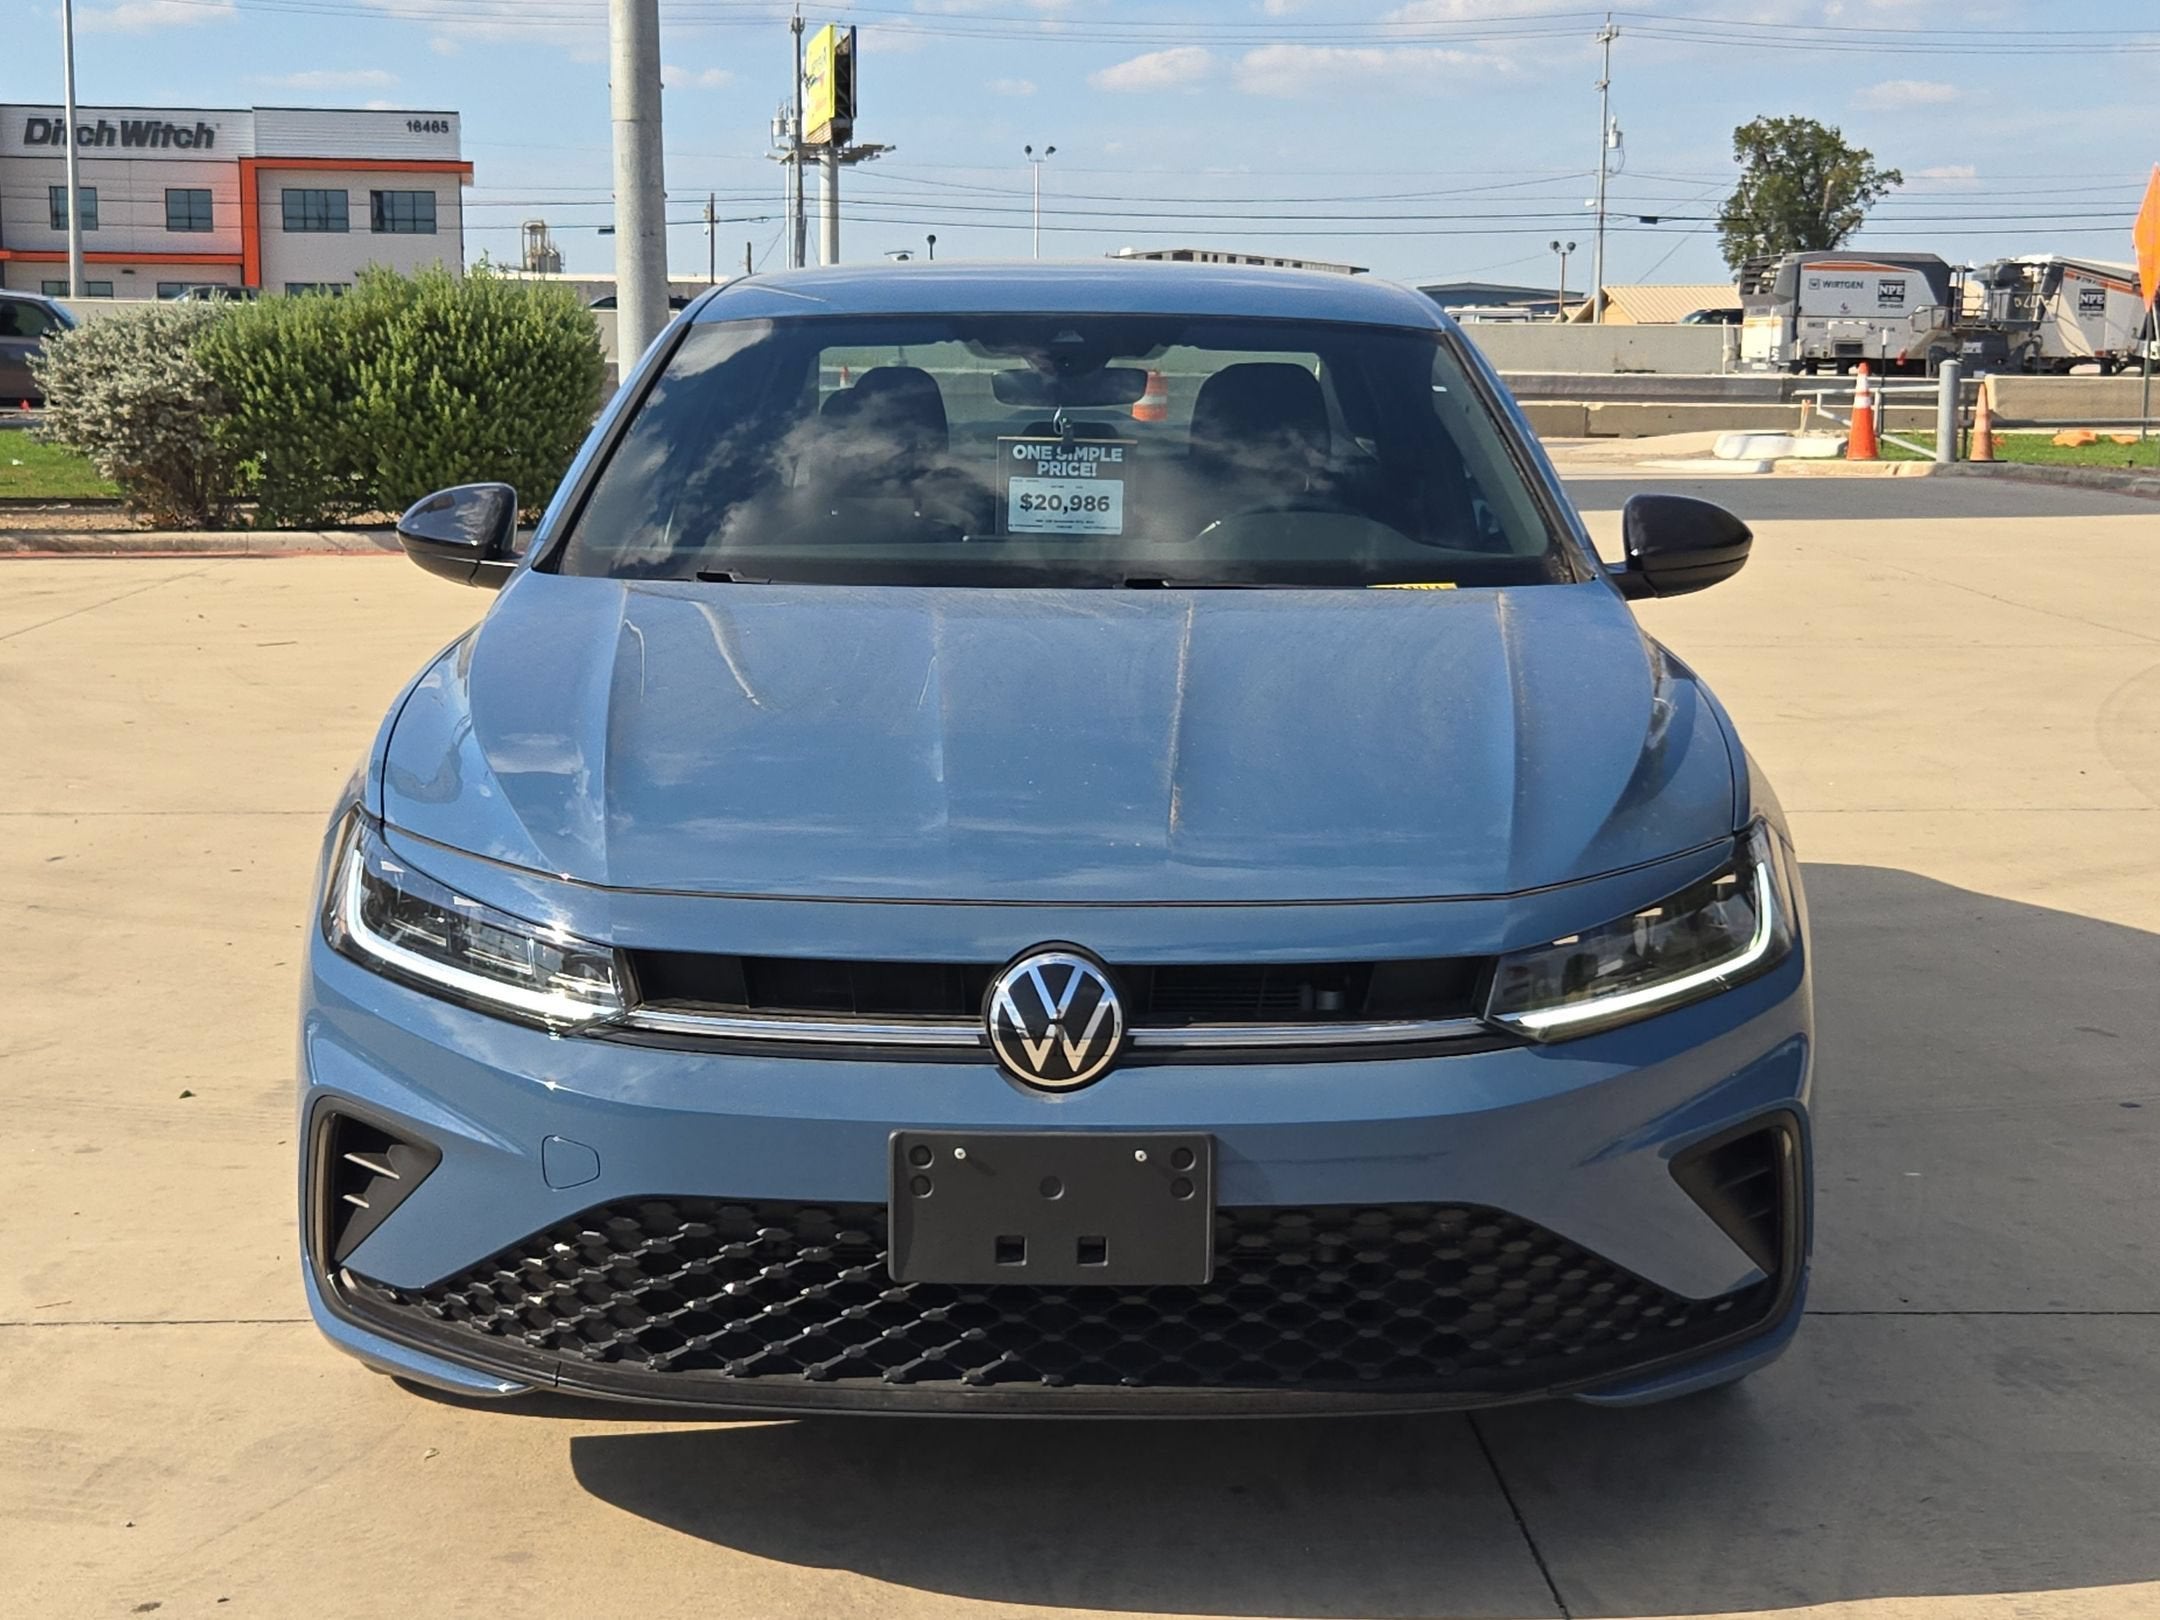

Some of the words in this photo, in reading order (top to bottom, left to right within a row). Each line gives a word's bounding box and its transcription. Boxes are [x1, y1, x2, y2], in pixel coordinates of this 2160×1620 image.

[23, 117, 117, 147] Dich
[120, 119, 216, 149] Witch
[1822, 280, 1864, 290] WIRTGEN
[1879, 284, 1905, 297] NPE
[2079, 293, 2105, 305] NPE
[1012, 445, 1052, 460] ONE
[1037, 461, 1097, 477] PRICE!
[1019, 493, 1110, 514] $20,986
